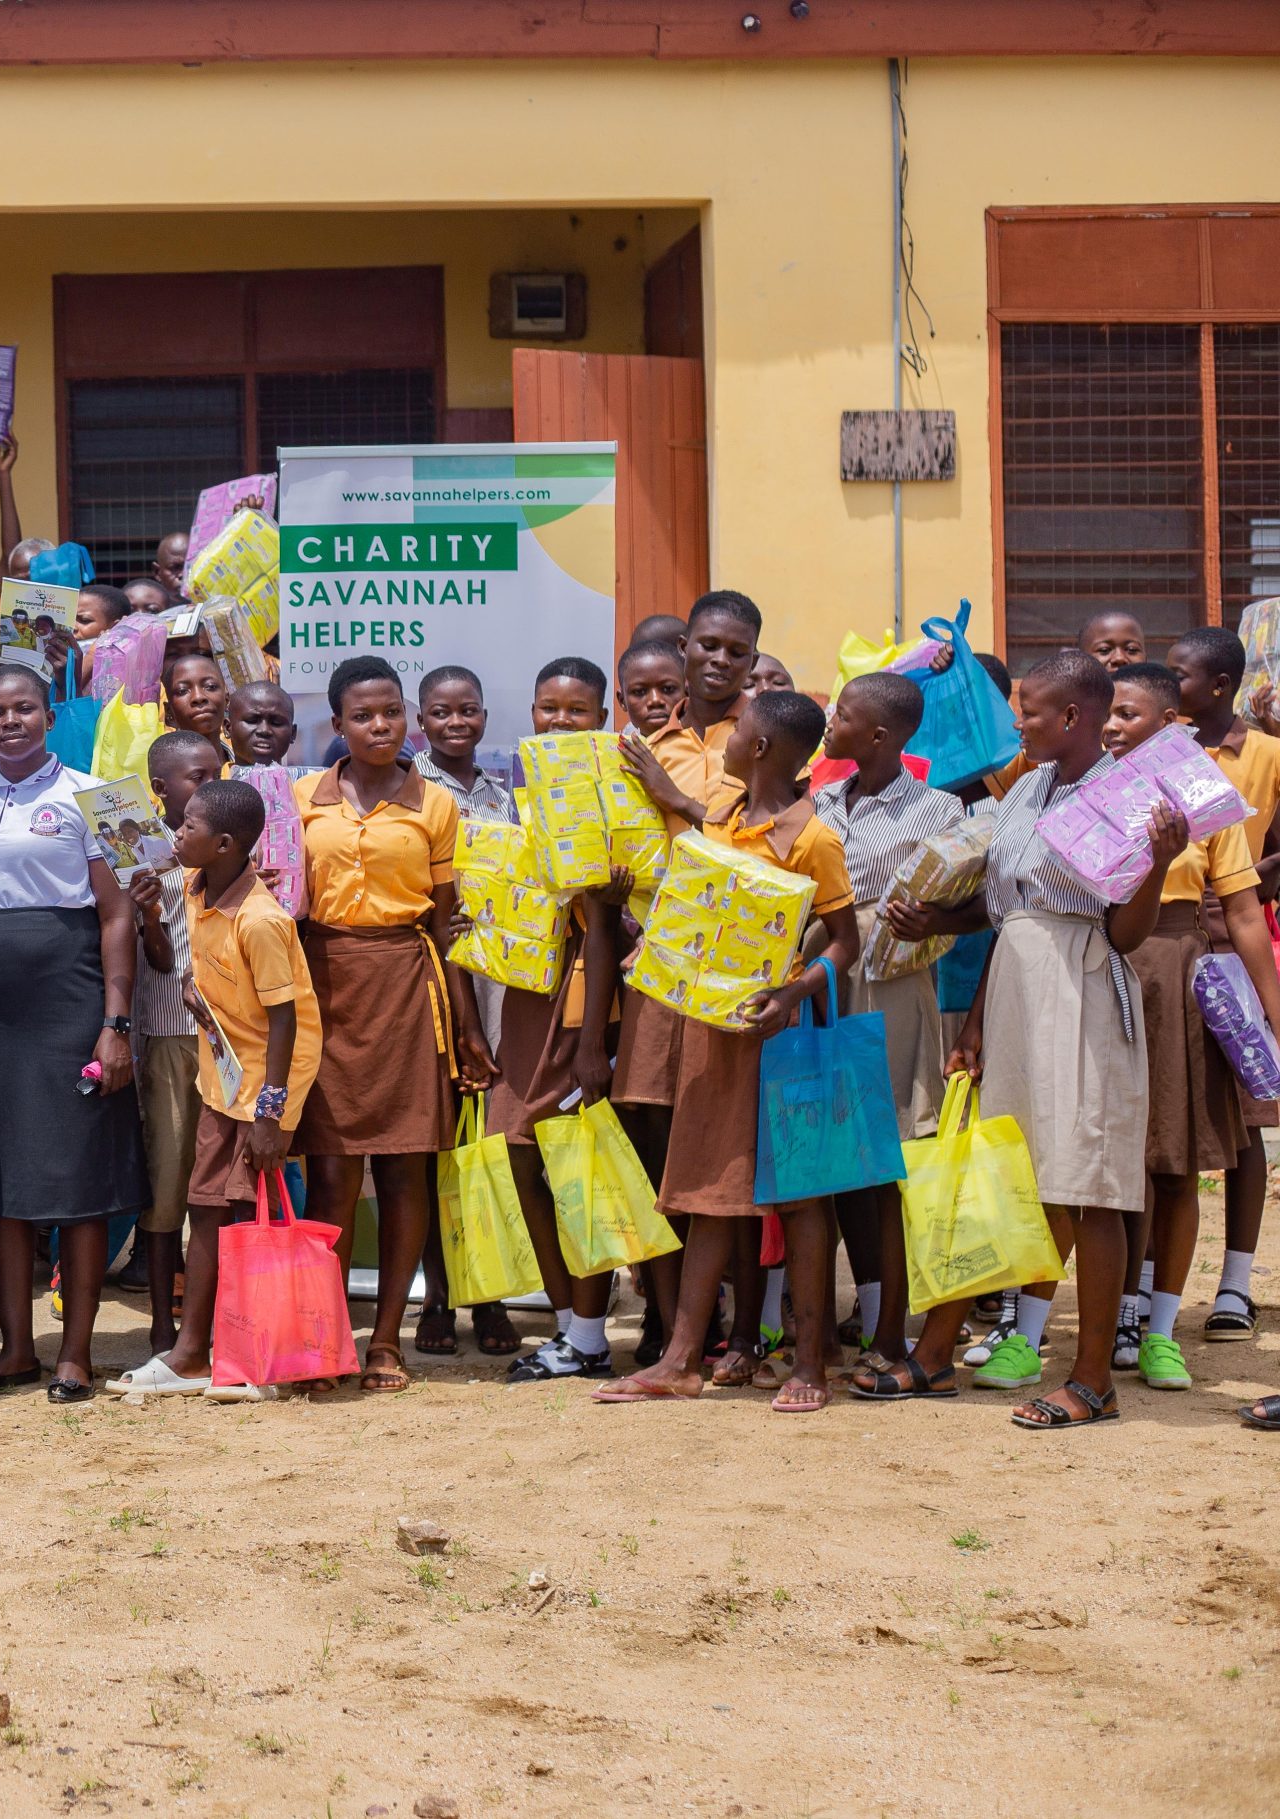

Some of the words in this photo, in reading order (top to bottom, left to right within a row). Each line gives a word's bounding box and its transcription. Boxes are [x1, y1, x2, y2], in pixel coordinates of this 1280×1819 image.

[342, 487, 551, 503] www.savannahelpers.com
[297, 534, 493, 564] CHARITY
[288, 579, 487, 607] SAVANNAH
[290, 620, 425, 648] HELPERS
[289, 660, 425, 674] FOUON
